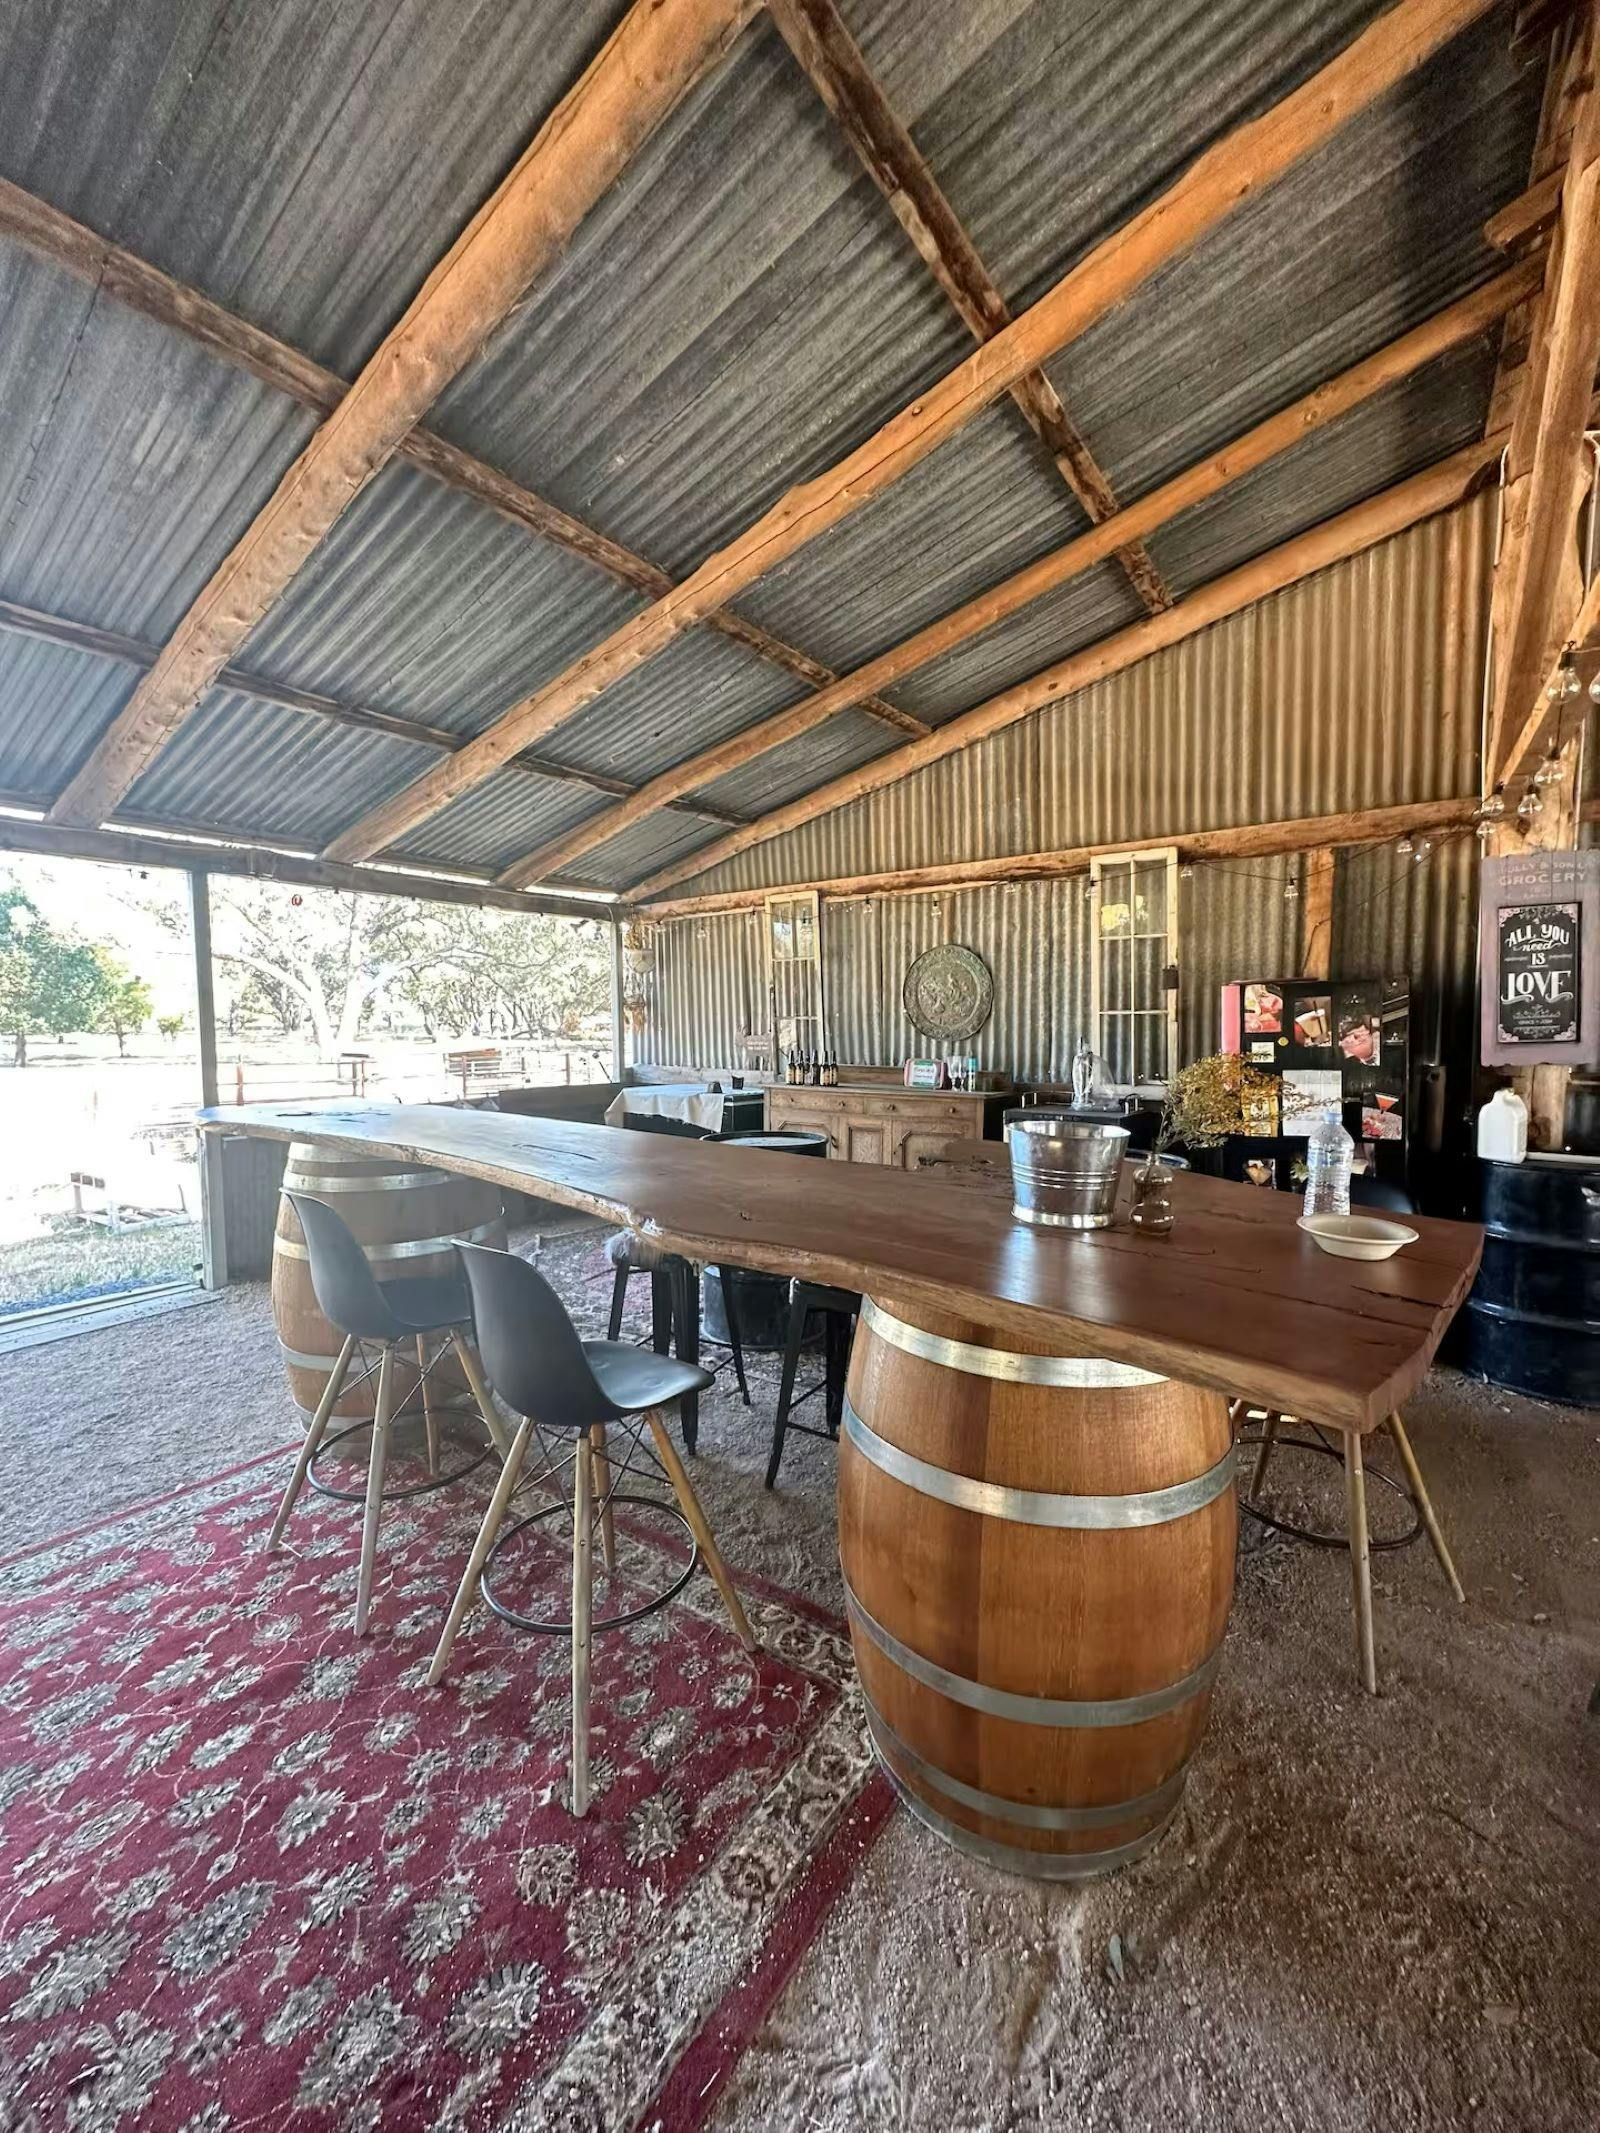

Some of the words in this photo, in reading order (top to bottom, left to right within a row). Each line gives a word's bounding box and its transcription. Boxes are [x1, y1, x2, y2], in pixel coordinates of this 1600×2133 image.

[1500, 863, 1535, 874] ULLY
[1499, 872, 1586, 886] GROCERY
[1504, 924, 1536, 947] ALL
[1541, 924, 1570, 945] YOU
[1516, 938, 1558, 952] need
[1532, 952, 1546, 966] IS
[1501, 970, 1574, 1004] LOVE
